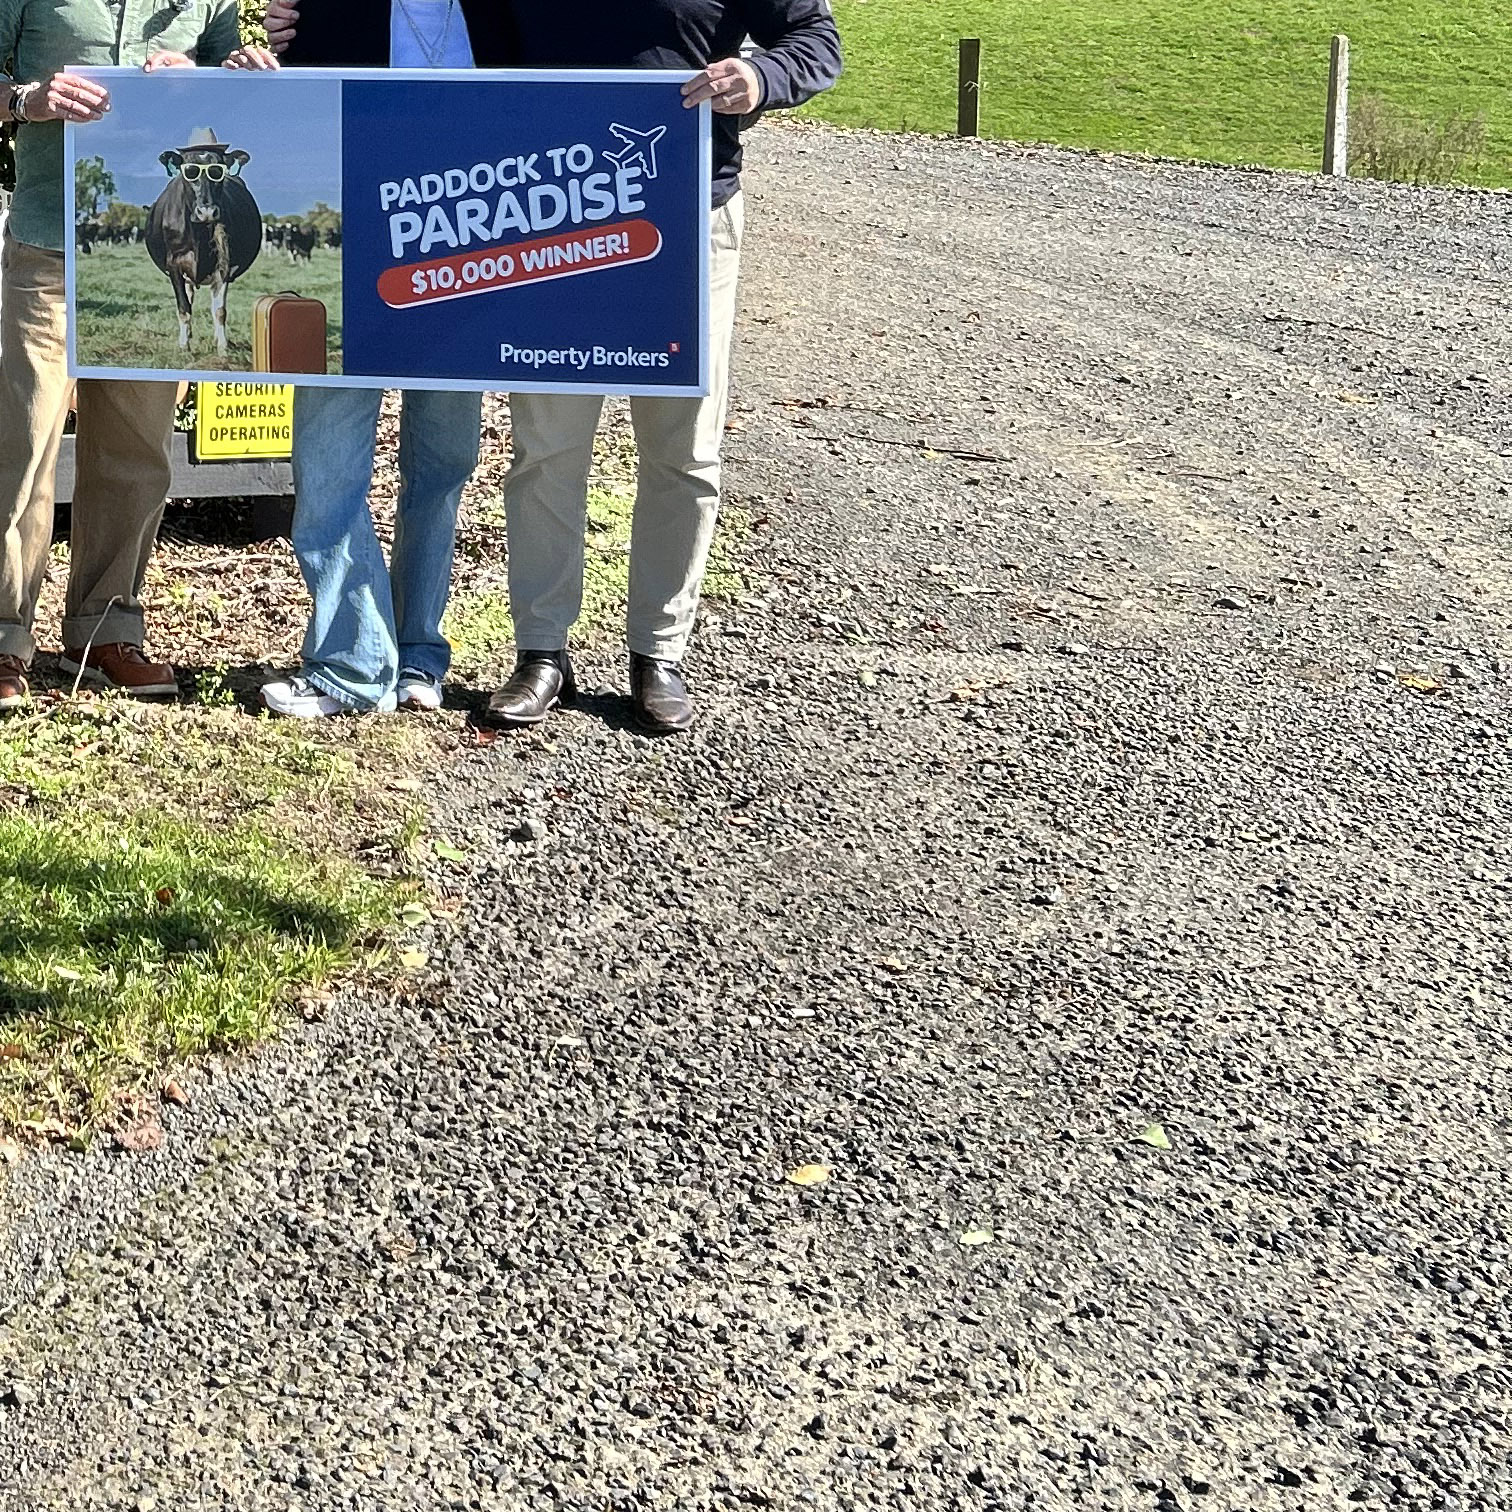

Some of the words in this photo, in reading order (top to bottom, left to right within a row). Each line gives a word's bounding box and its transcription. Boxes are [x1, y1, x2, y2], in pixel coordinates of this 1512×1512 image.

[379, 152, 542, 211] PADDOCK
[545, 142, 595, 178] TO
[388, 166, 646, 259] PARADISE
[410, 254, 514, 296] $10,000
[520, 231, 629, 273] WINNER!
[500, 343, 591, 371] Property
[593, 345, 669, 367] Brokers
[209, 425, 290, 442] OPERATING
[215, 402, 286, 419] CAMERAS
